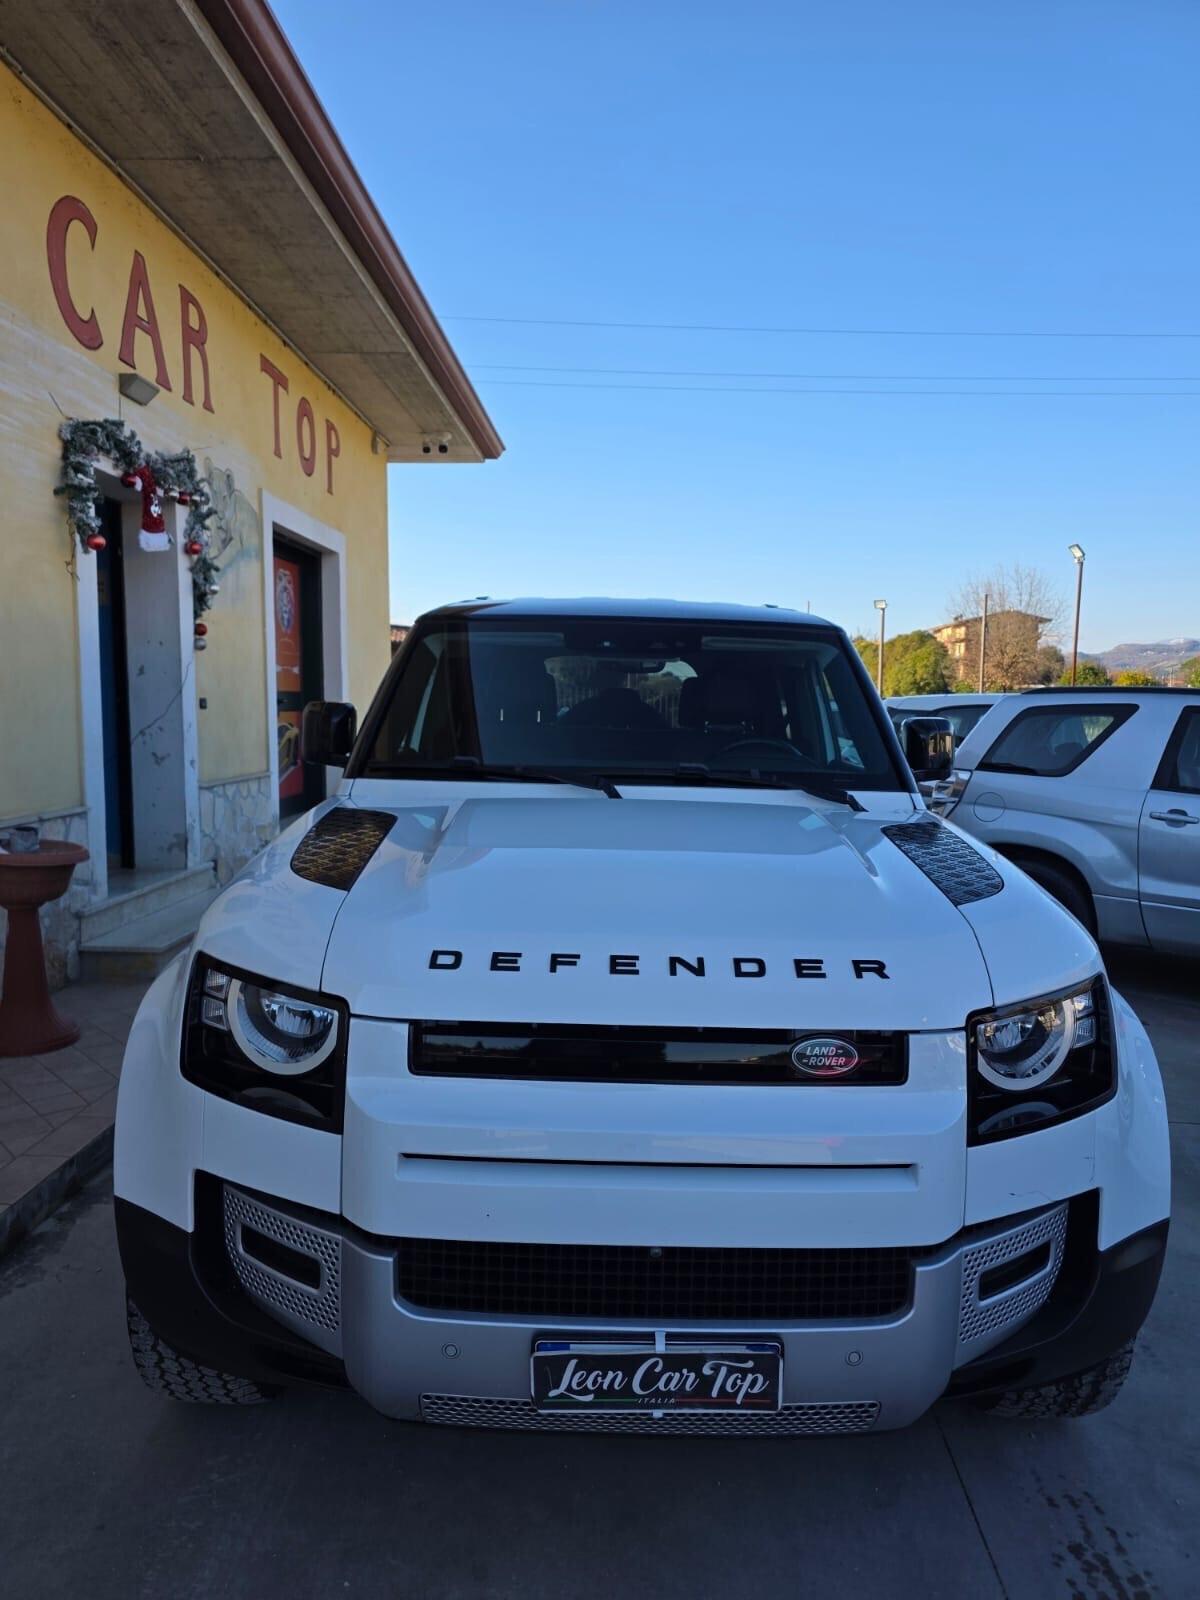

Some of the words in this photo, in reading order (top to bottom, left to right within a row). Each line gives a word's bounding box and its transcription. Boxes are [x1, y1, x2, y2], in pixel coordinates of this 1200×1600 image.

[47, 195, 215, 414] CAR
[260, 353, 341, 495] TOP
[428, 949, 890, 979] DEFENDER
[548, 1358, 628, 1401] Leon
[631, 1357, 699, 1396] Car
[702, 1360, 769, 1405] Top
